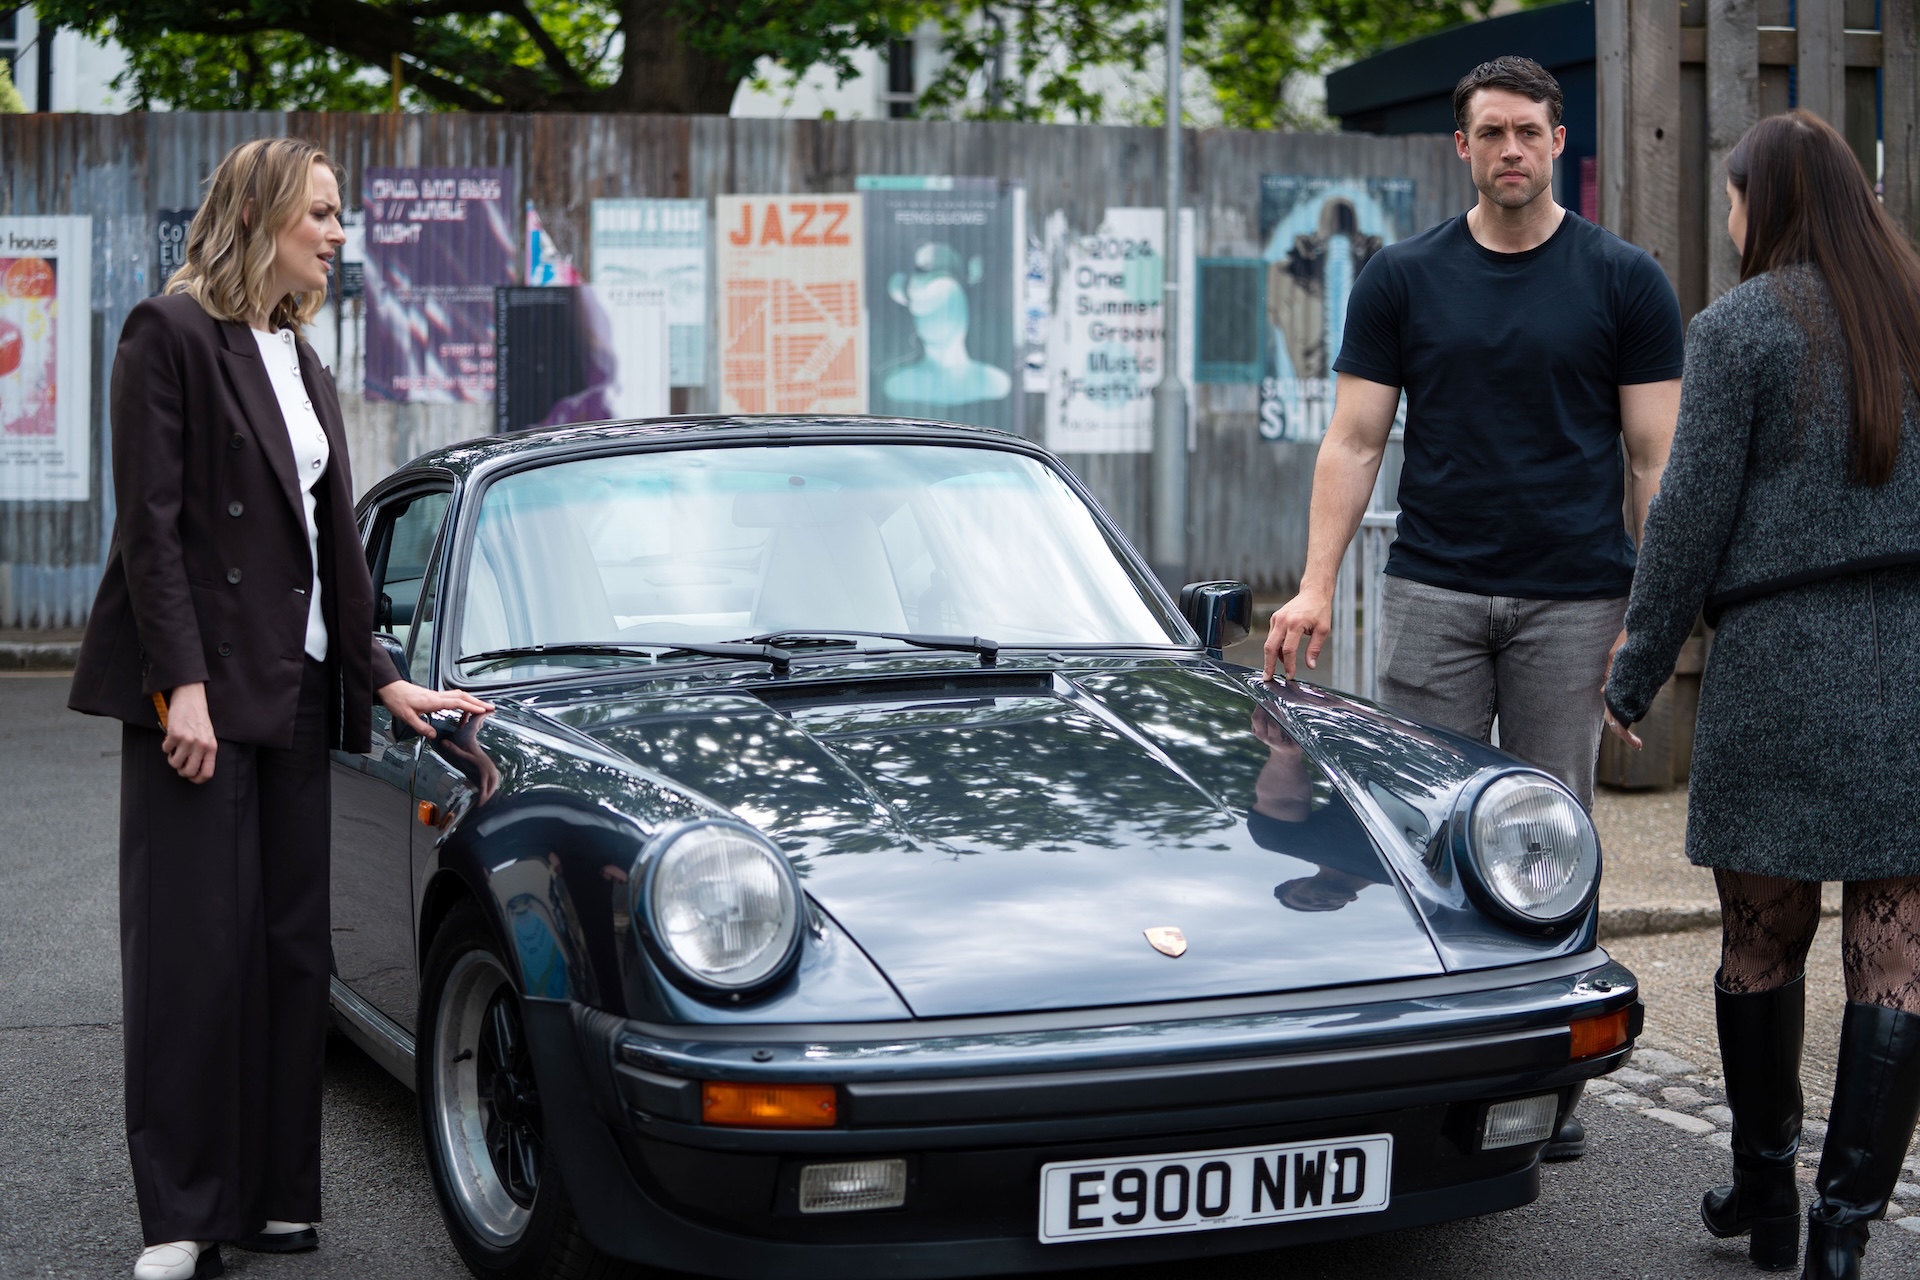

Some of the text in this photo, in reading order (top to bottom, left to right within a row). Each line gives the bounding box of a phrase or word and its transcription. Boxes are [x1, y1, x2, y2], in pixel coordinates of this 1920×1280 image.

[729, 203, 850, 246] JAZZ
[9, 231, 57, 250] house
[1076, 295, 1161, 316] Summer
[1087, 347, 1156, 374] Music
[1067, 377, 1153, 401] Festiv
[1068, 1147, 1366, 1230] E900 NWD
